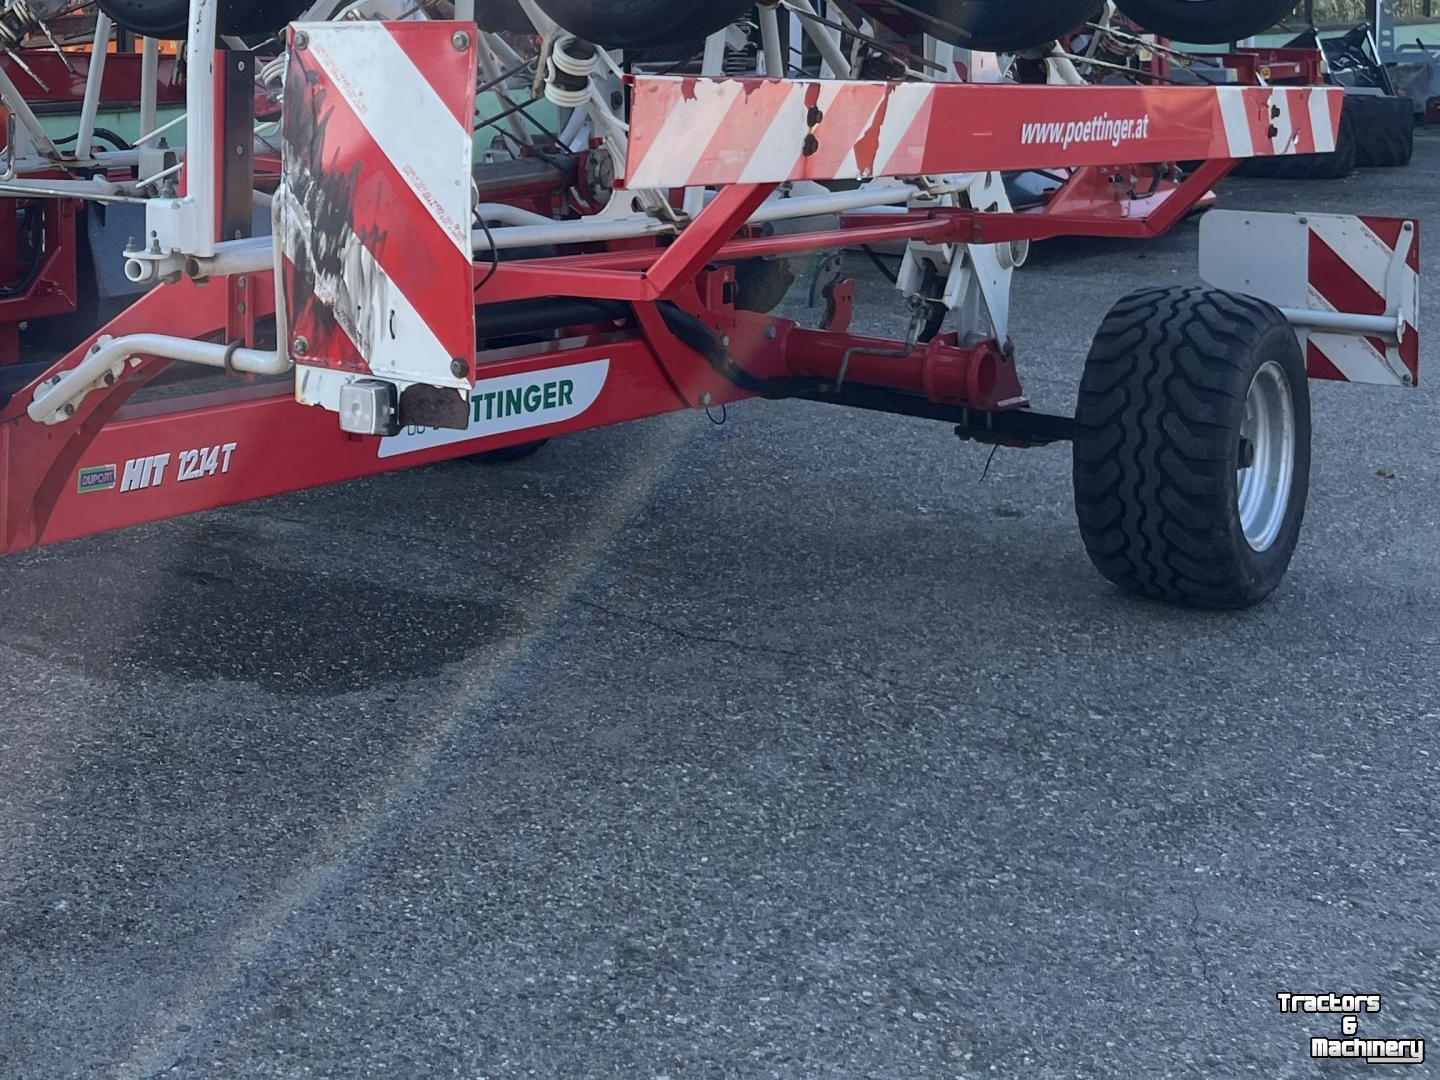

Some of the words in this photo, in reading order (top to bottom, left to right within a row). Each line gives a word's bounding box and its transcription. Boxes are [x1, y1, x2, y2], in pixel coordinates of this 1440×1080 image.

[1021, 112, 1149, 149] www.poettinger.at
[468, 379, 574, 423] TTINGER
[120, 453, 171, 492] HIT
[222, 442, 237, 473] T
